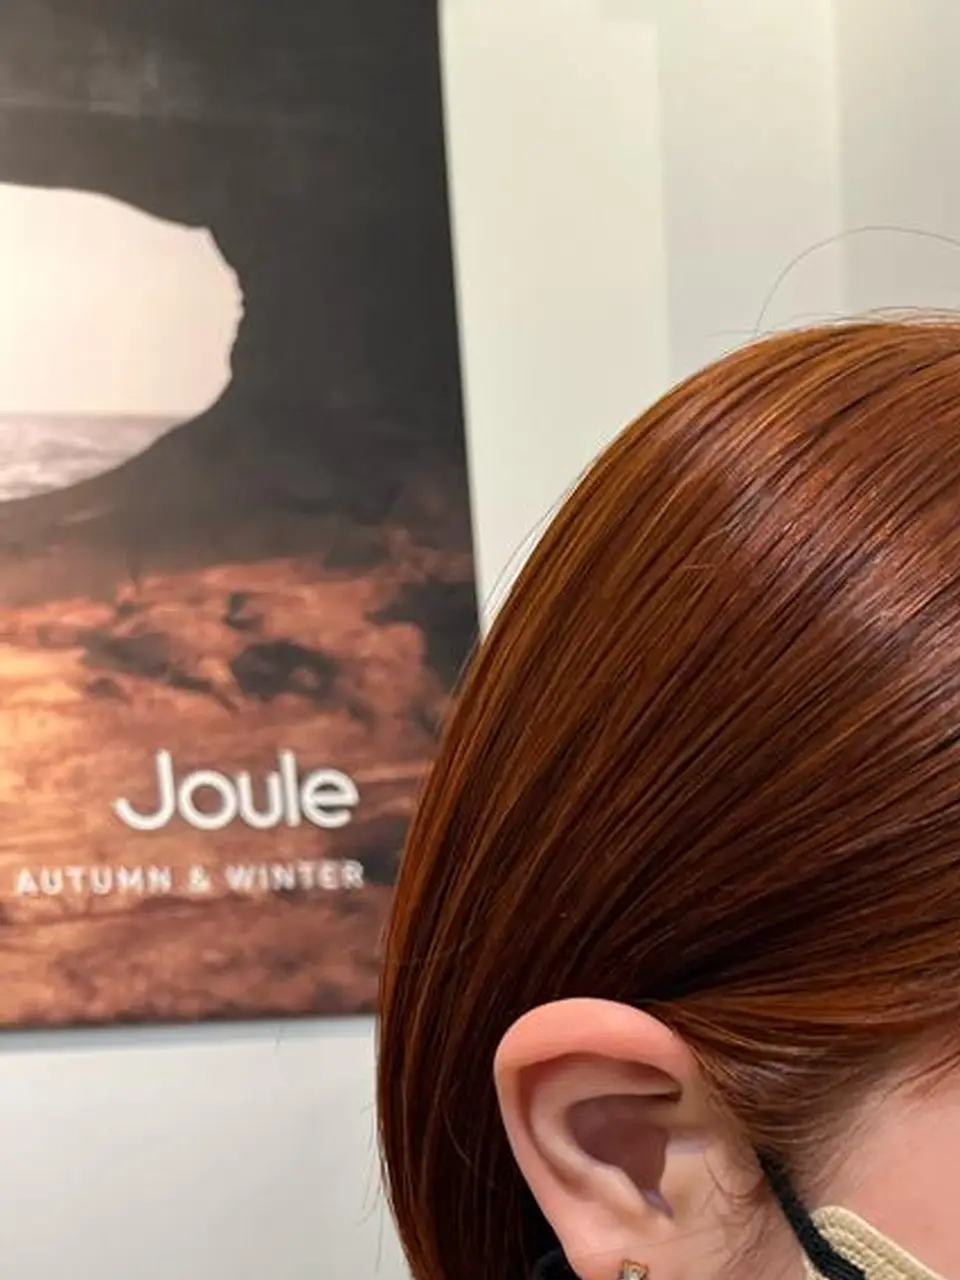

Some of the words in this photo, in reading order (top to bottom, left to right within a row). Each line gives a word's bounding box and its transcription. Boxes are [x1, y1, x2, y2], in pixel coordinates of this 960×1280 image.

[113, 749, 360, 830] Joule
[16, 864, 172, 895] AUTUMN
[189, 865, 211, 893] &
[227, 859, 365, 890] WINTER
